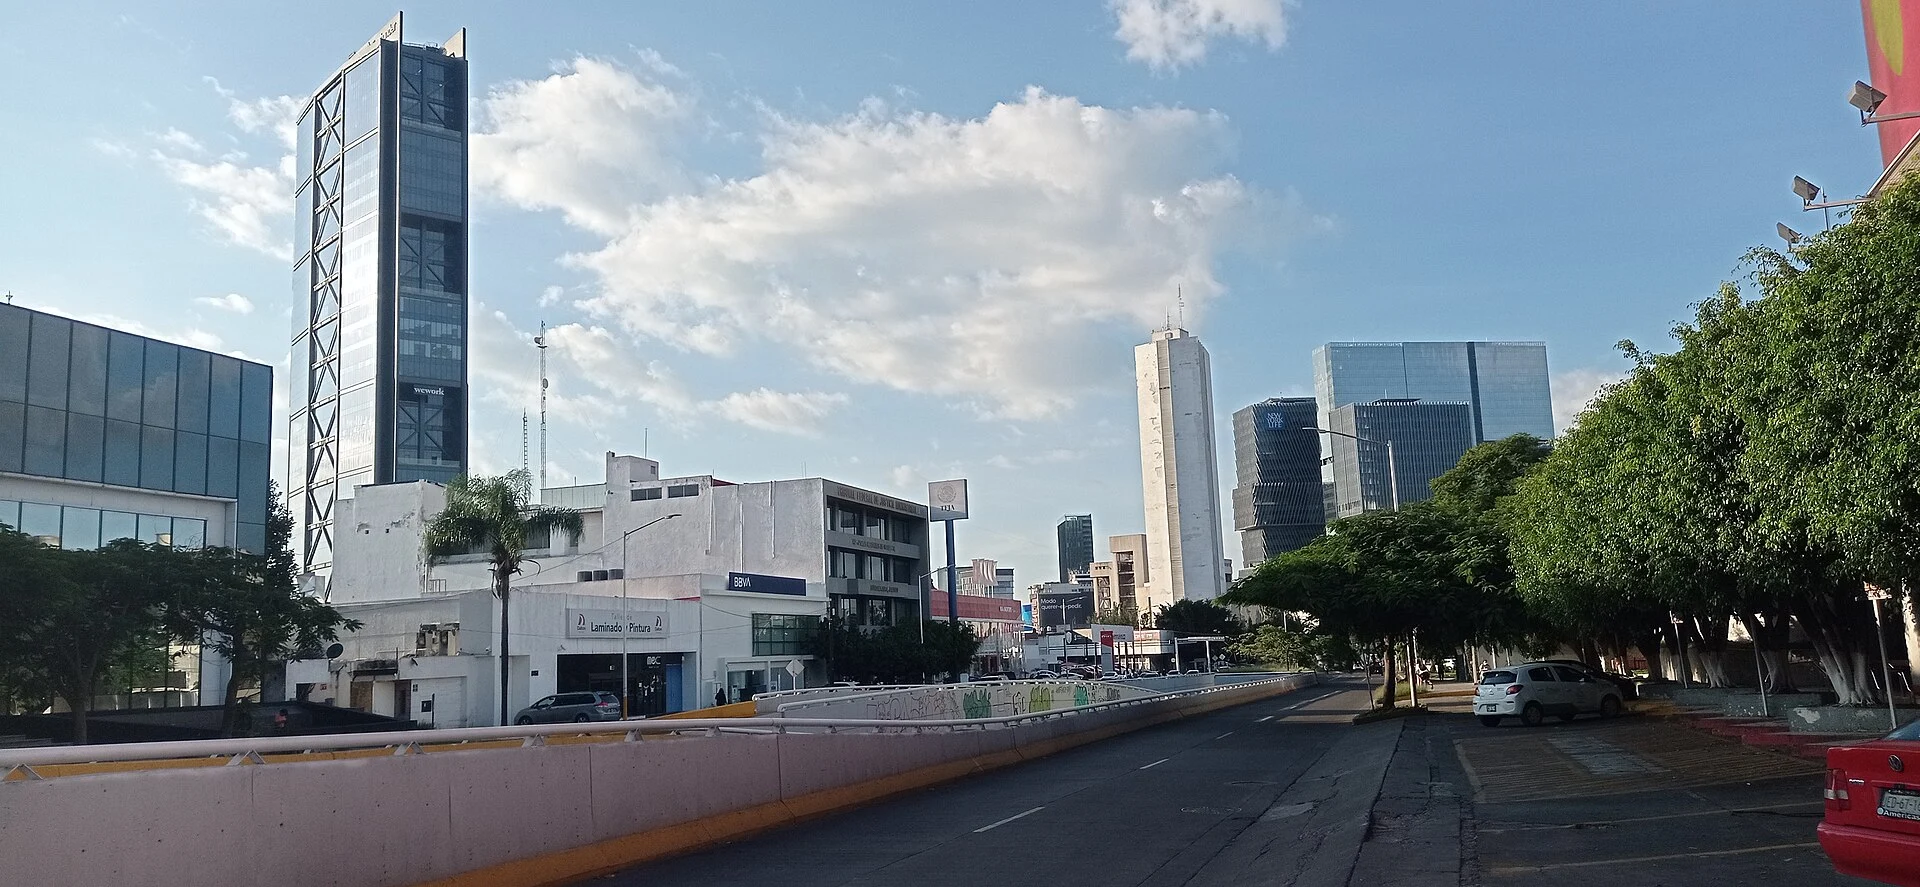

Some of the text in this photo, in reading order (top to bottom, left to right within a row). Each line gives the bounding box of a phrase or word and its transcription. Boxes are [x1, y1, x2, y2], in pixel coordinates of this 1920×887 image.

[413, 387, 445, 396] wework
[733, 576, 752, 588] BBVA
[590, 622, 623, 633] Laminado
[629, 622, 651, 633] Pintura
